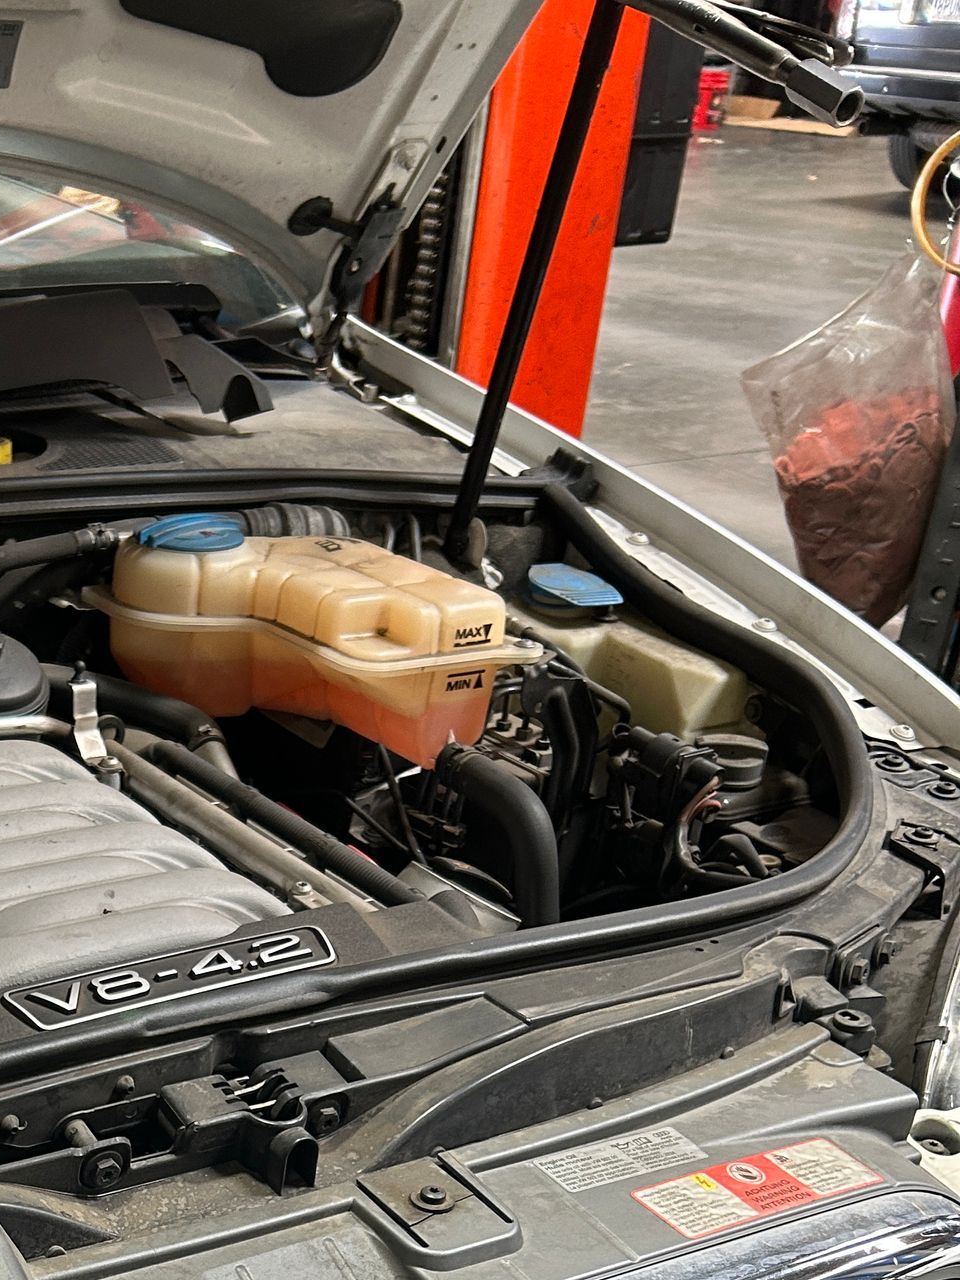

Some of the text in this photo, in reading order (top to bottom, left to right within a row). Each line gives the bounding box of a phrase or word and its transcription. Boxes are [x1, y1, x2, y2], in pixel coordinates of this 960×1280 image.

[455, 627, 483, 640] MAX
[445, 679, 472, 692] MIN
[745, 1179, 791, 1197] ACHTUNG
[752, 1186, 800, 1204] WARNING
[757, 1192, 812, 1211] ATTENTION
